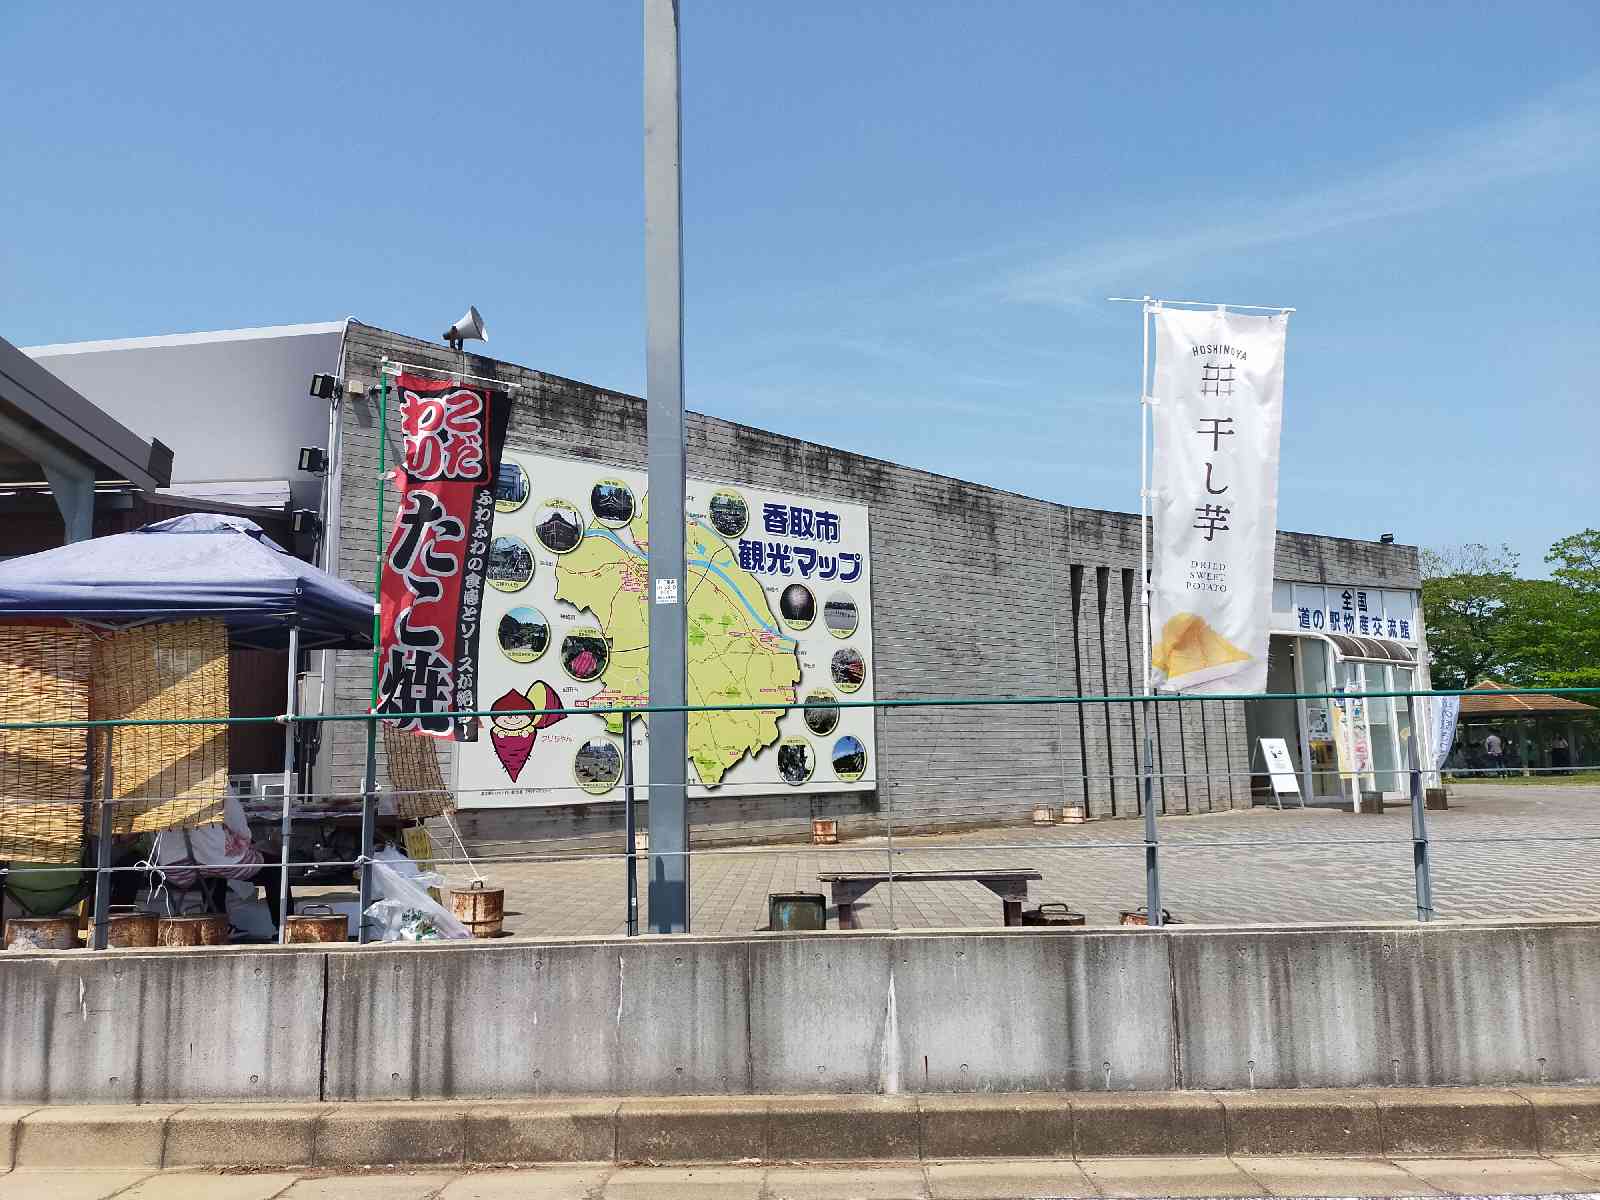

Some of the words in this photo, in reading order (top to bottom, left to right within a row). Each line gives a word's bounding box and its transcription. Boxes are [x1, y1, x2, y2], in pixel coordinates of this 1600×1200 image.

[1192, 344, 1247, 361] HOSHINOYA
[1193, 416, 1236, 542] 干し芋
[762, 502, 841, 543] 香取市
[737, 537, 864, 582] 観光マップ
[1191, 560, 1226, 571] DRIED
[1186, 581, 1227, 592] POTATO
[1189, 571, 1226, 582] SWEET
[377, 488, 465, 736] たこ焼
[1341, 590, 1368, 613] 全国
[1297, 607, 1411, 640] 道の駅物産交流館
